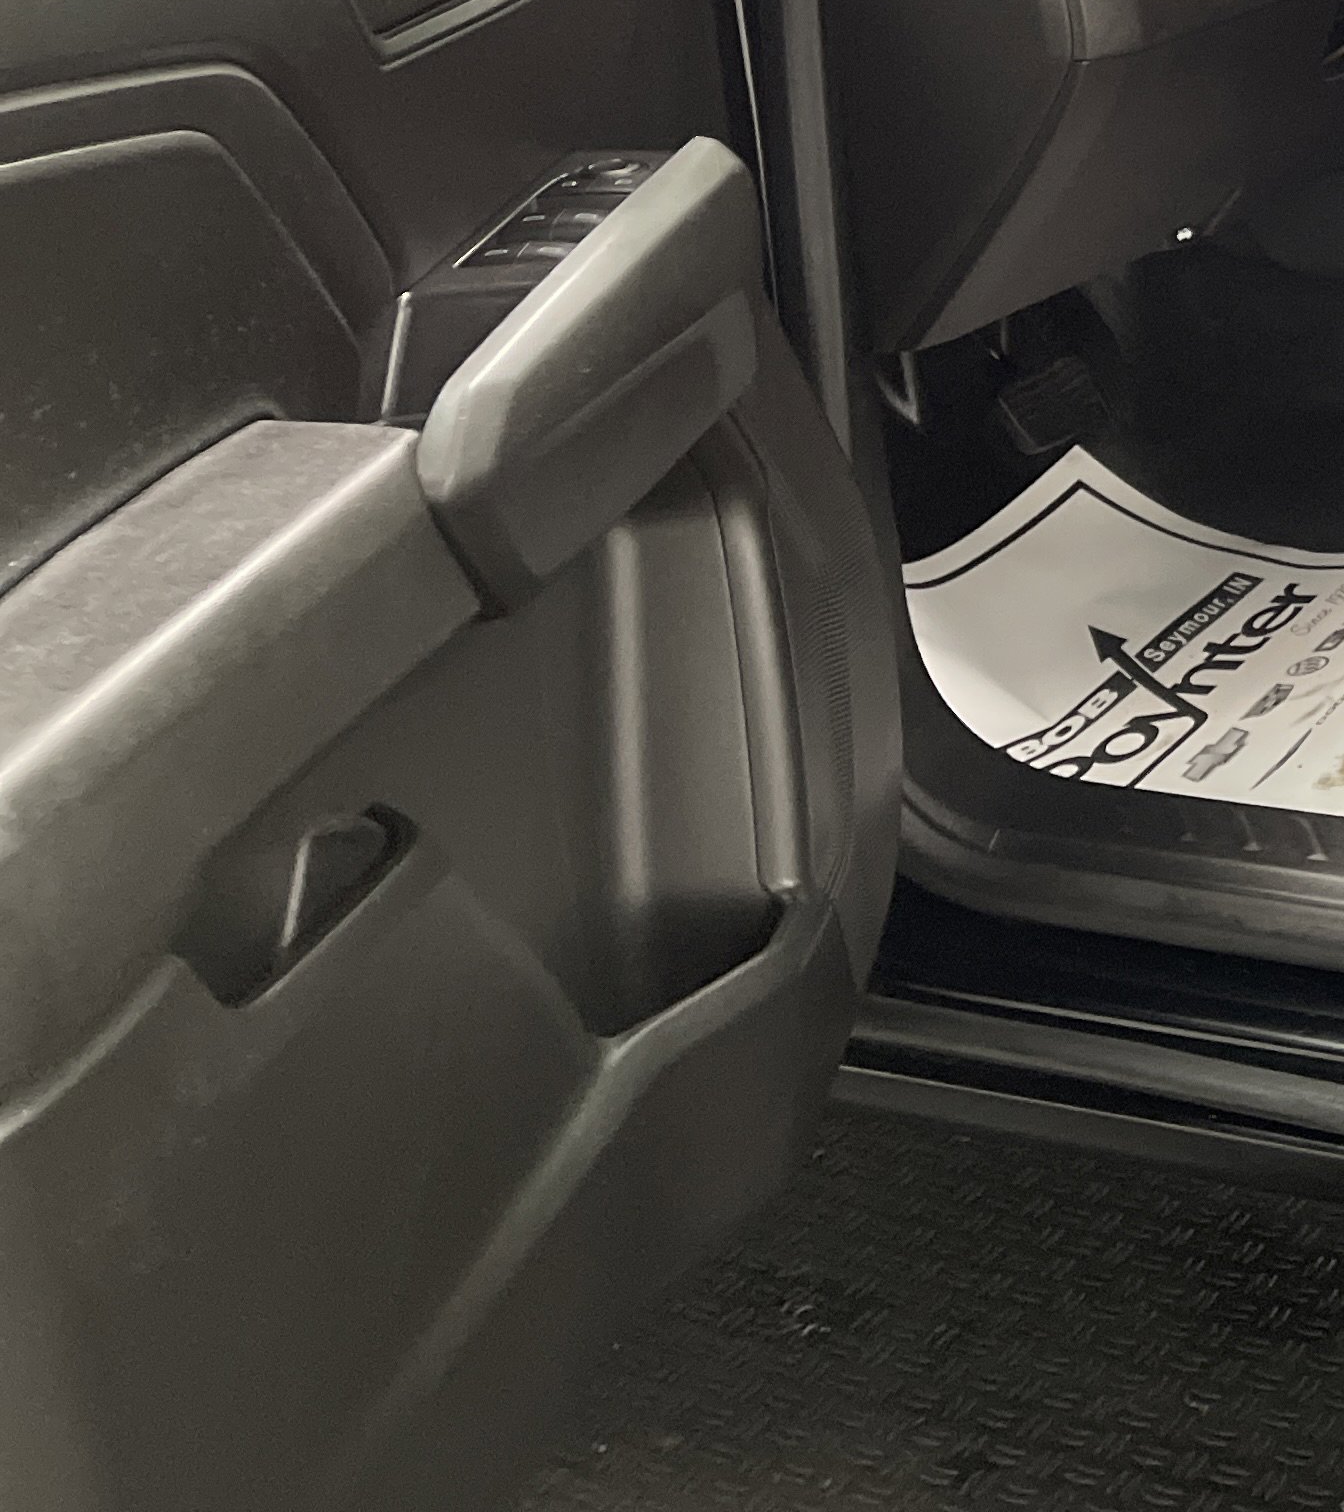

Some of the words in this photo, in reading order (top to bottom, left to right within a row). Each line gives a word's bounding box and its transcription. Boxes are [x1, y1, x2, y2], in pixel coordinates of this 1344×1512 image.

[1143, 598, 1235, 662] Seymour,
[1222, 577, 1252, 595] IN
[1006, 689, 1119, 763] BOB
